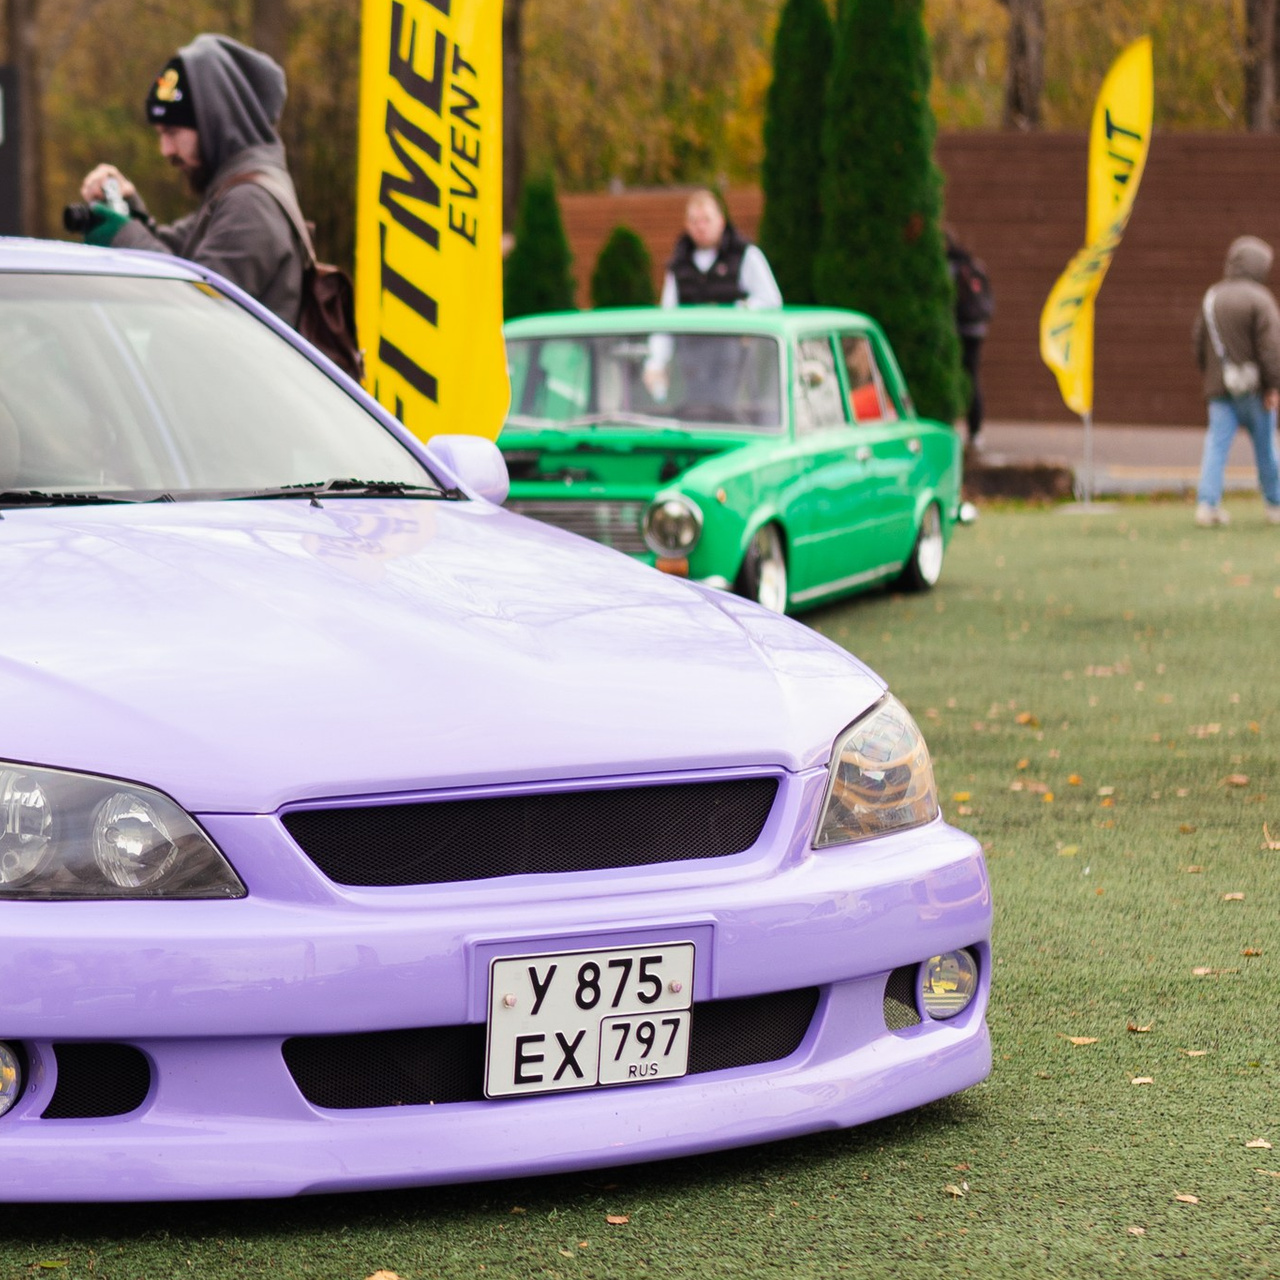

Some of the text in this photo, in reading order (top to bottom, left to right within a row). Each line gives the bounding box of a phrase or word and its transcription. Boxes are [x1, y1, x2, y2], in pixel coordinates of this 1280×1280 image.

[448, 43, 481, 247] EVENT
[574, 955, 663, 1011] 875
[611, 1017, 681, 1061] 797
[628, 1062, 659, 1078] RUS
